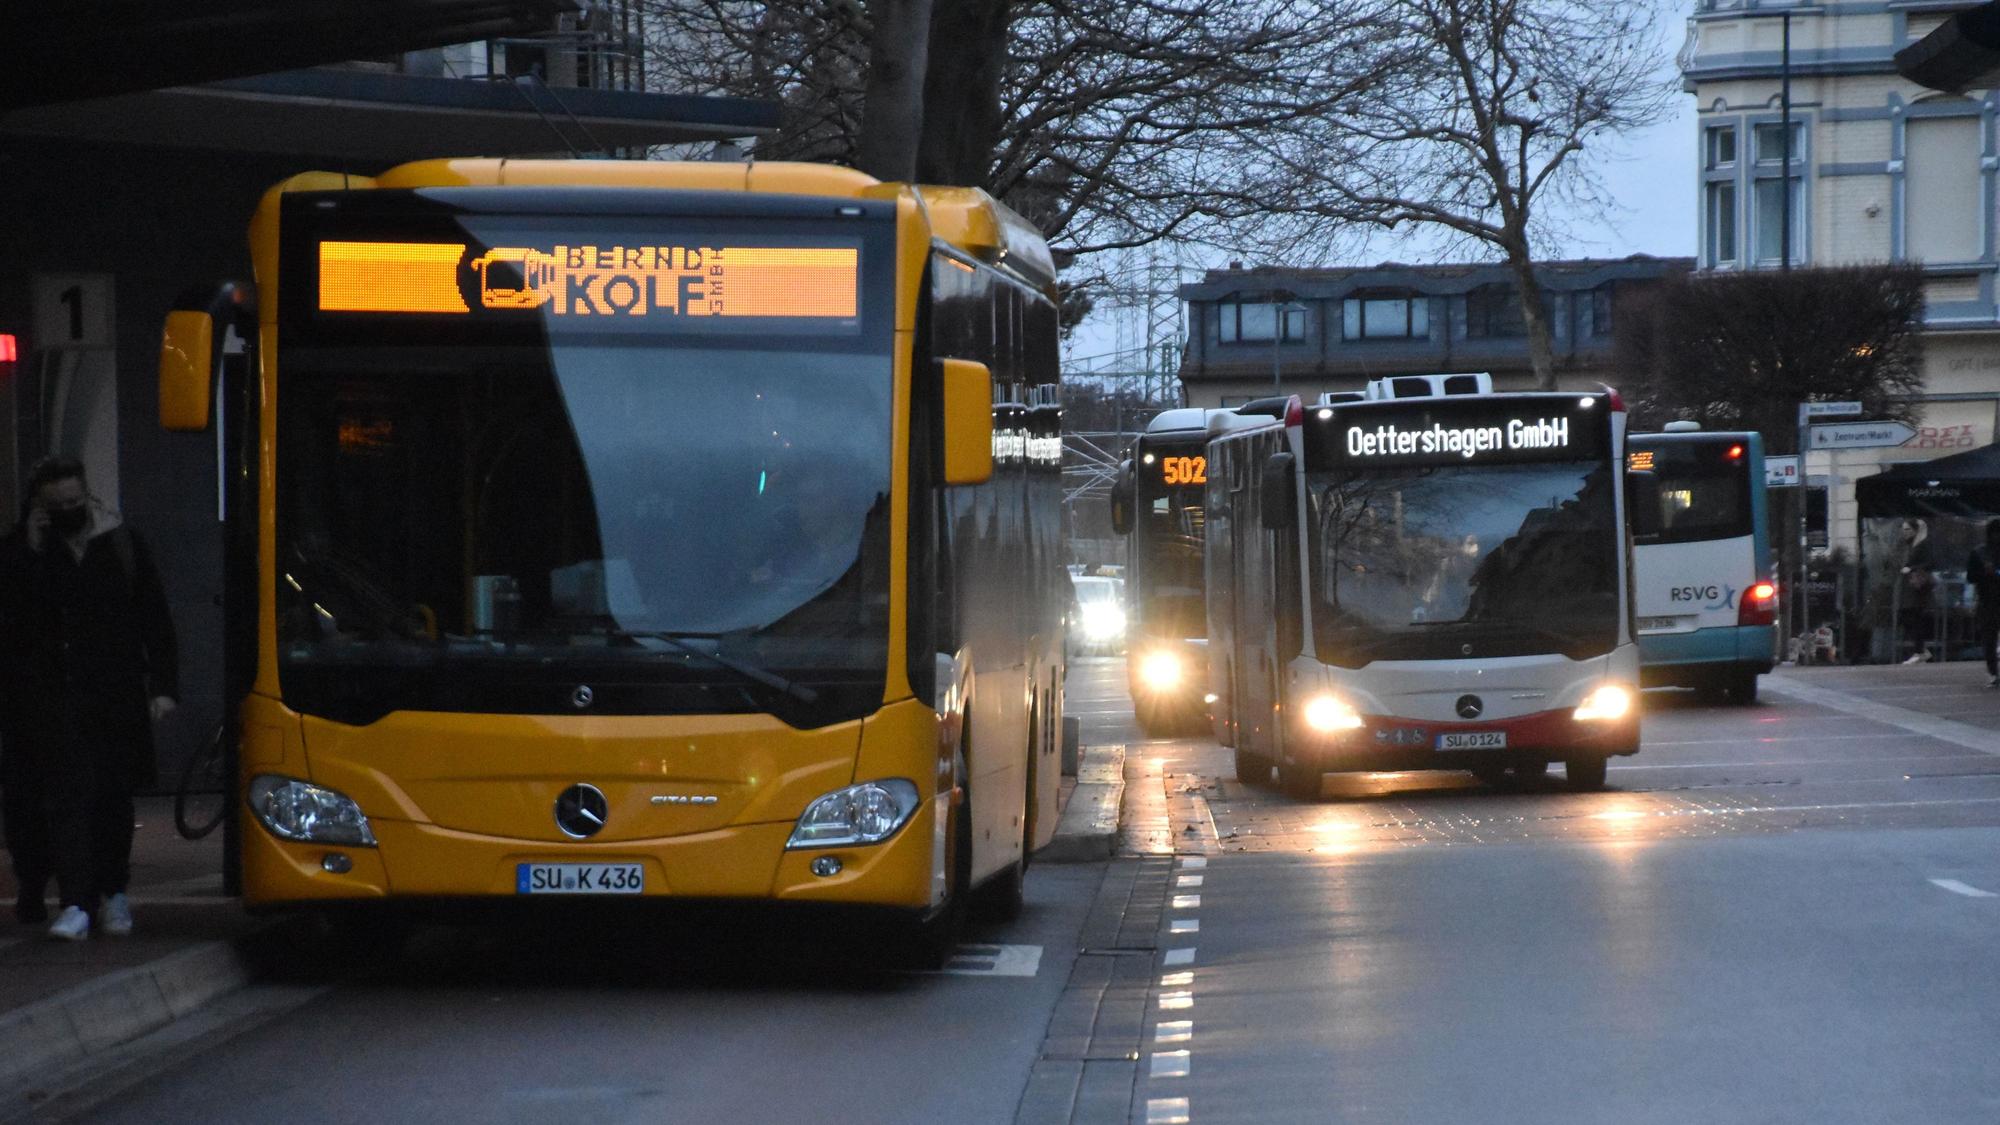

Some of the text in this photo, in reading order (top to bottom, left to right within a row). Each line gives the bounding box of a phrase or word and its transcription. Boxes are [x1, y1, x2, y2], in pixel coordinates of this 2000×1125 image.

[566, 247, 703, 270] BERND
[566, 273, 705, 315] KOLF
[60, 284, 83, 340] 1
[1347, 416, 1569, 458] Oettershagen GmbH
[1162, 456, 1207, 485] 502
[1671, 585, 1719, 602] RSVG
[1446, 735, 1463, 748] SU
[1479, 734, 1502, 747] 124
[531, 867, 641, 889] SU K 436
